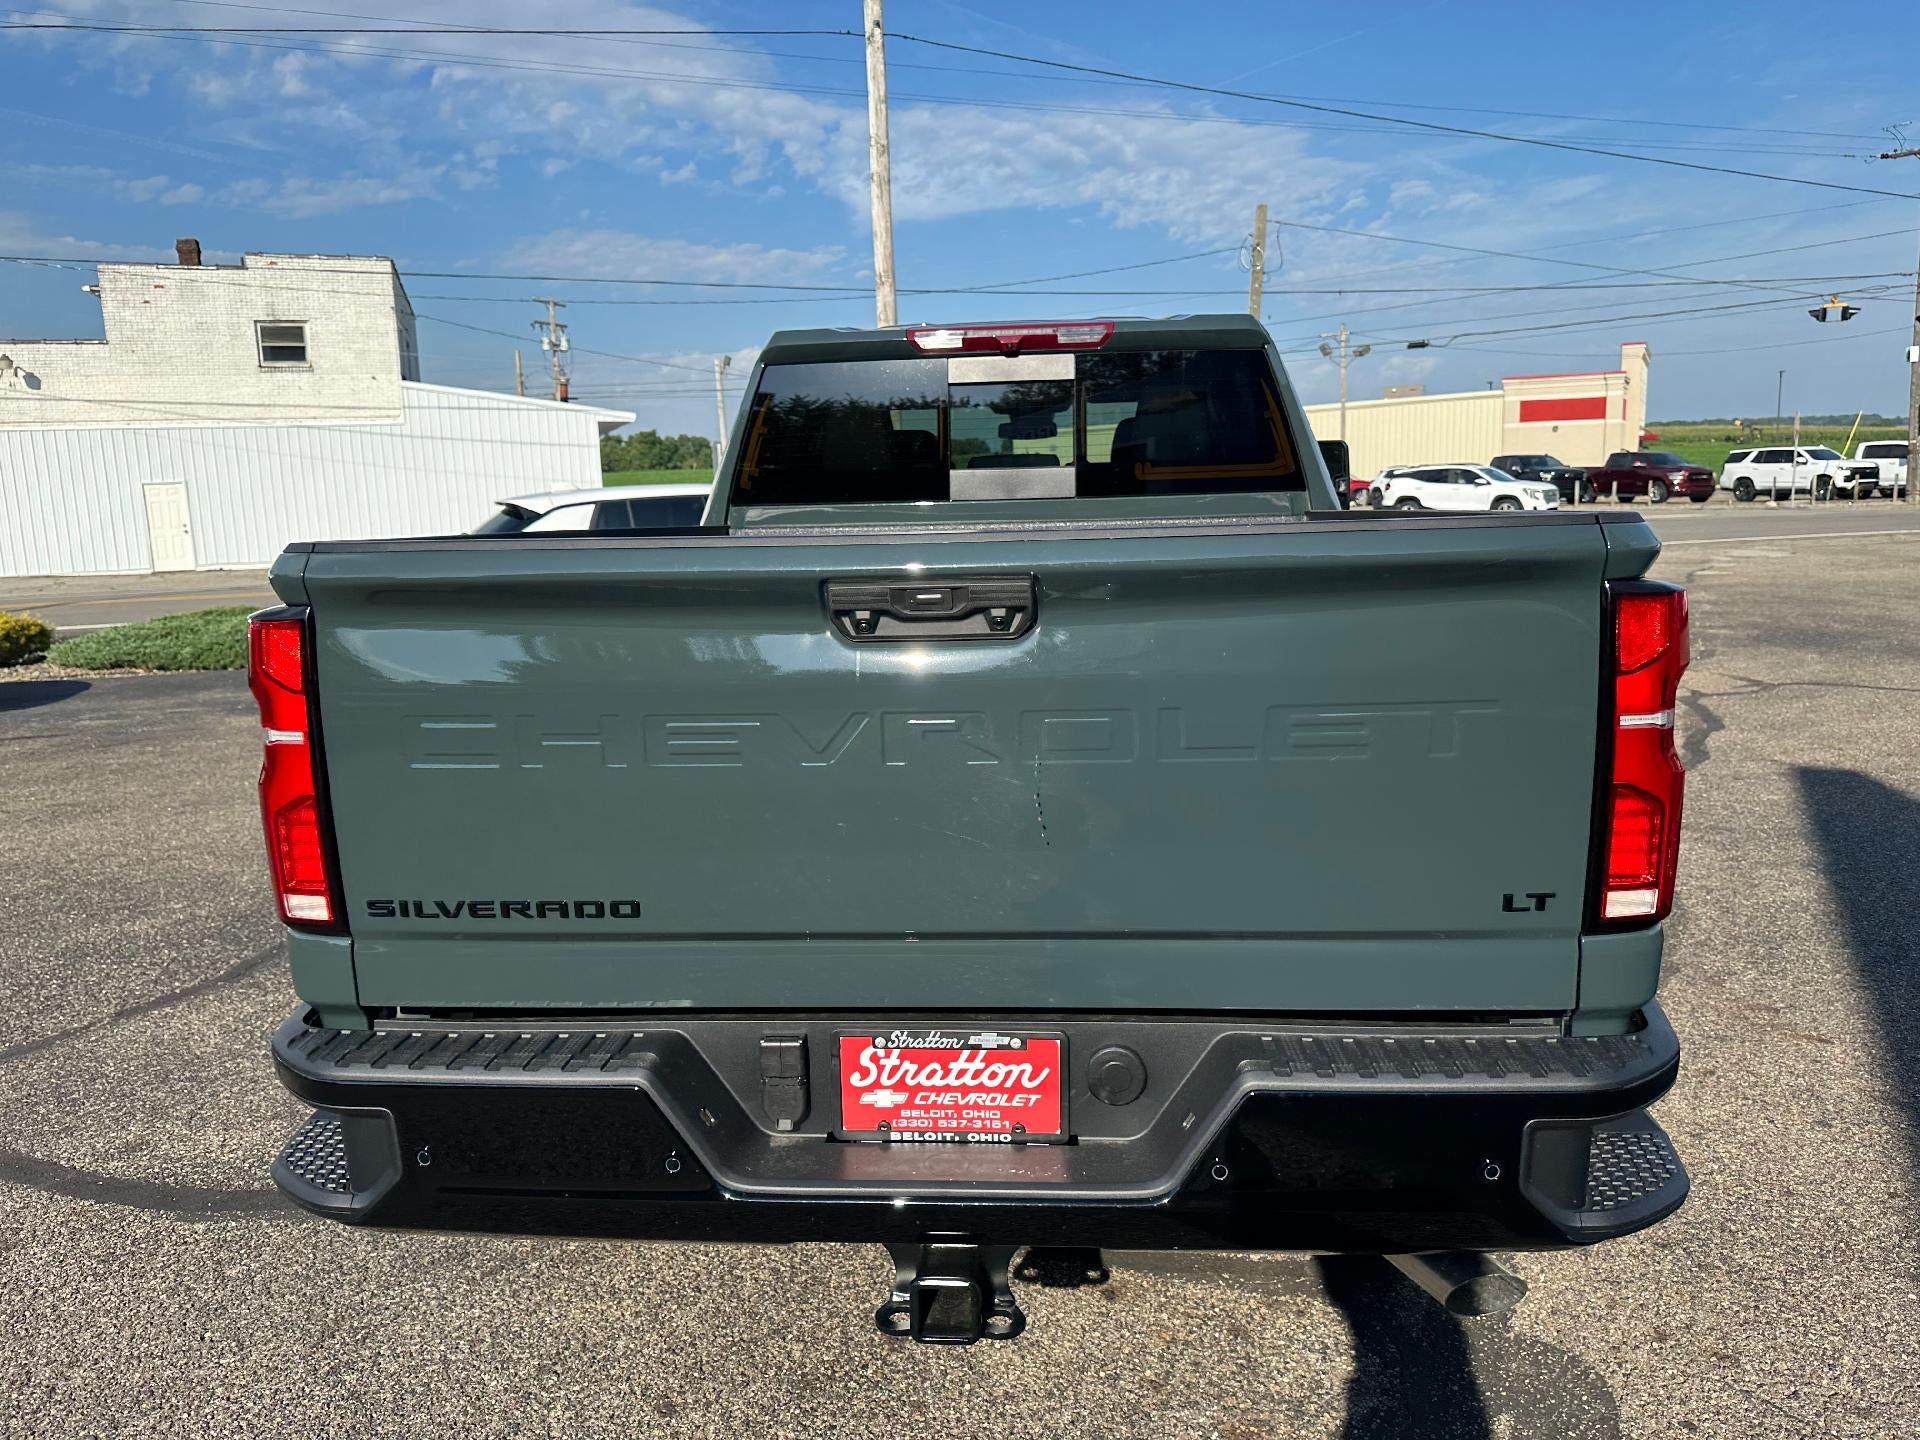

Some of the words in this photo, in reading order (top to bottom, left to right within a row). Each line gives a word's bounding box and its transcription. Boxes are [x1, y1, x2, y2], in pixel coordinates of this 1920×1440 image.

[402, 697, 1502, 769] CHEVROLET
[366, 899, 641, 919] SILVERADO
[1502, 892, 1556, 912] LT
[886, 1030, 964, 1049] Stratton
[850, 1045, 1050, 1088] Stratton
[914, 1091, 1042, 1107] CHEVROLET
[892, 1119, 933, 1128] (330)
[938, 1119, 1010, 1128] 537-3151
[900, 1109, 957, 1119] BELOIT,
[962, 1109, 1001, 1118] OHIO
[967, 1132, 1012, 1142] OHIO
